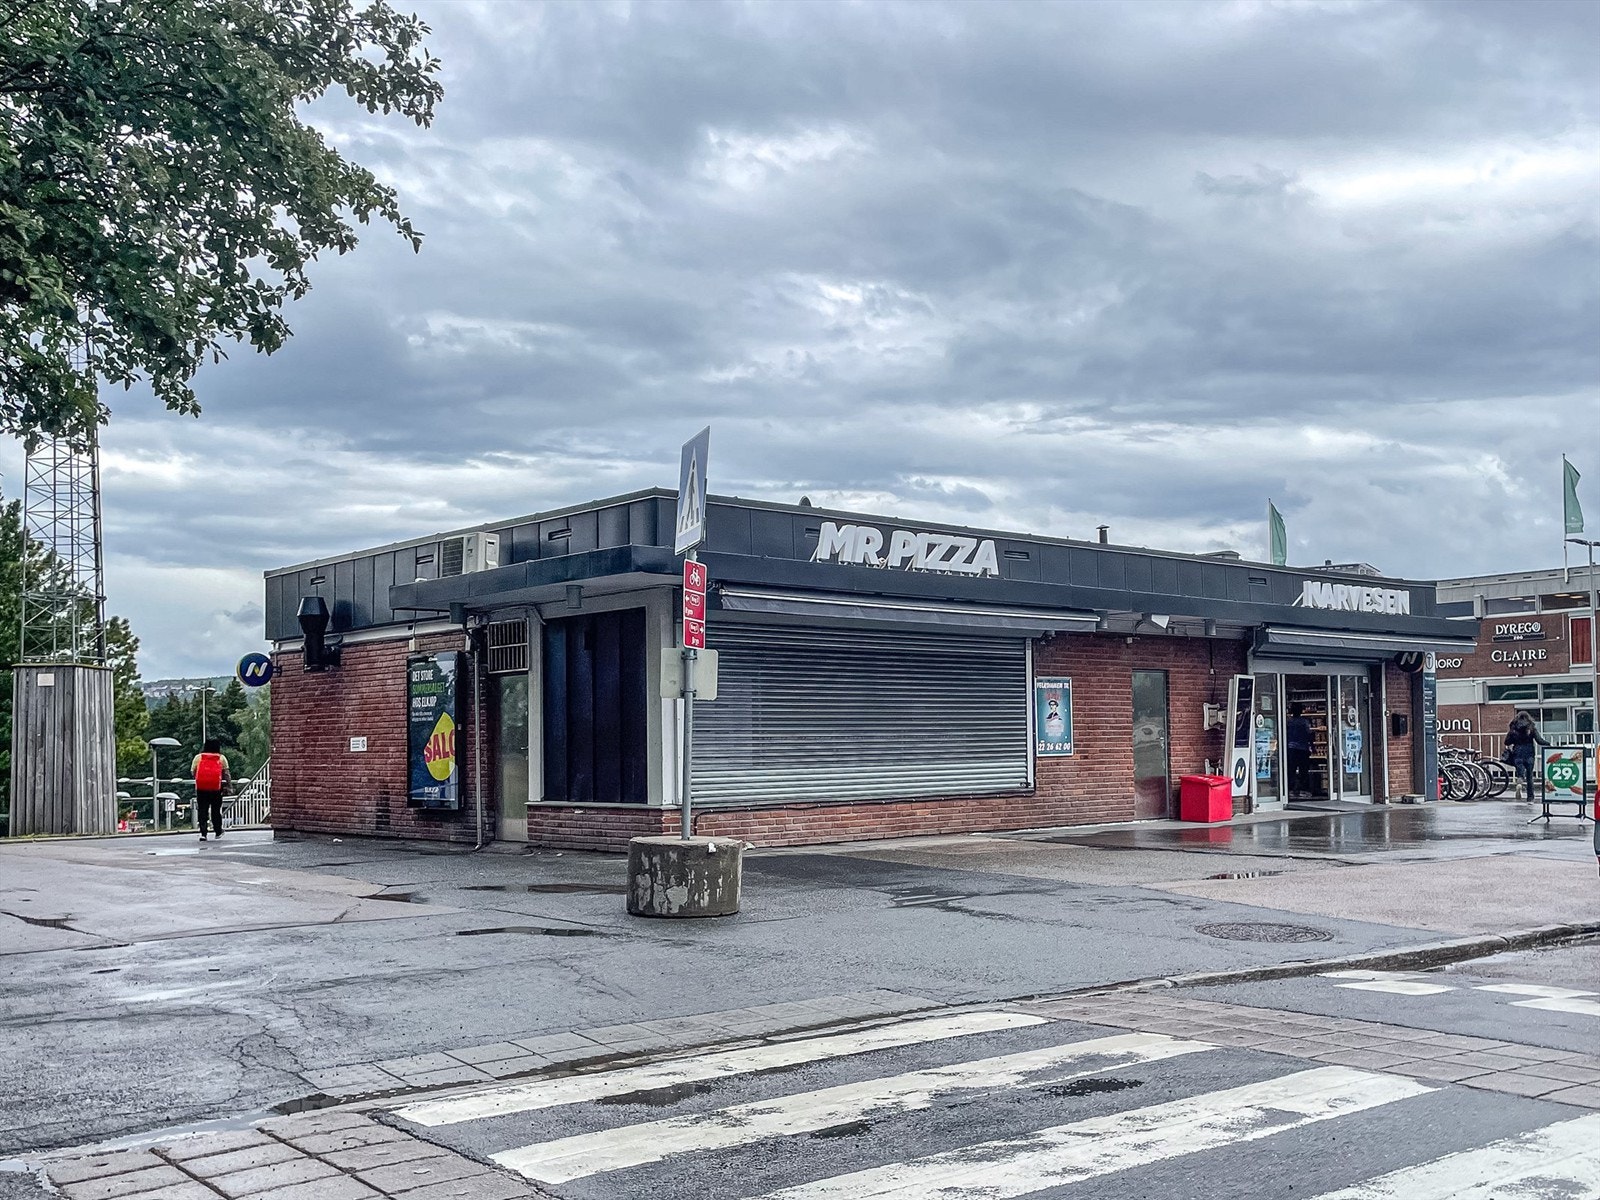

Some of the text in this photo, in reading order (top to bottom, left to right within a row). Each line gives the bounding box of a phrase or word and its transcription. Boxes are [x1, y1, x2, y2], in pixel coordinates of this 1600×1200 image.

[887, 530, 1000, 576] PIZZA
[1302, 580, 1410, 615] NARVESEN
[1491, 648, 1547, 662] CLAIRE
[412, 671, 420, 682] DET
